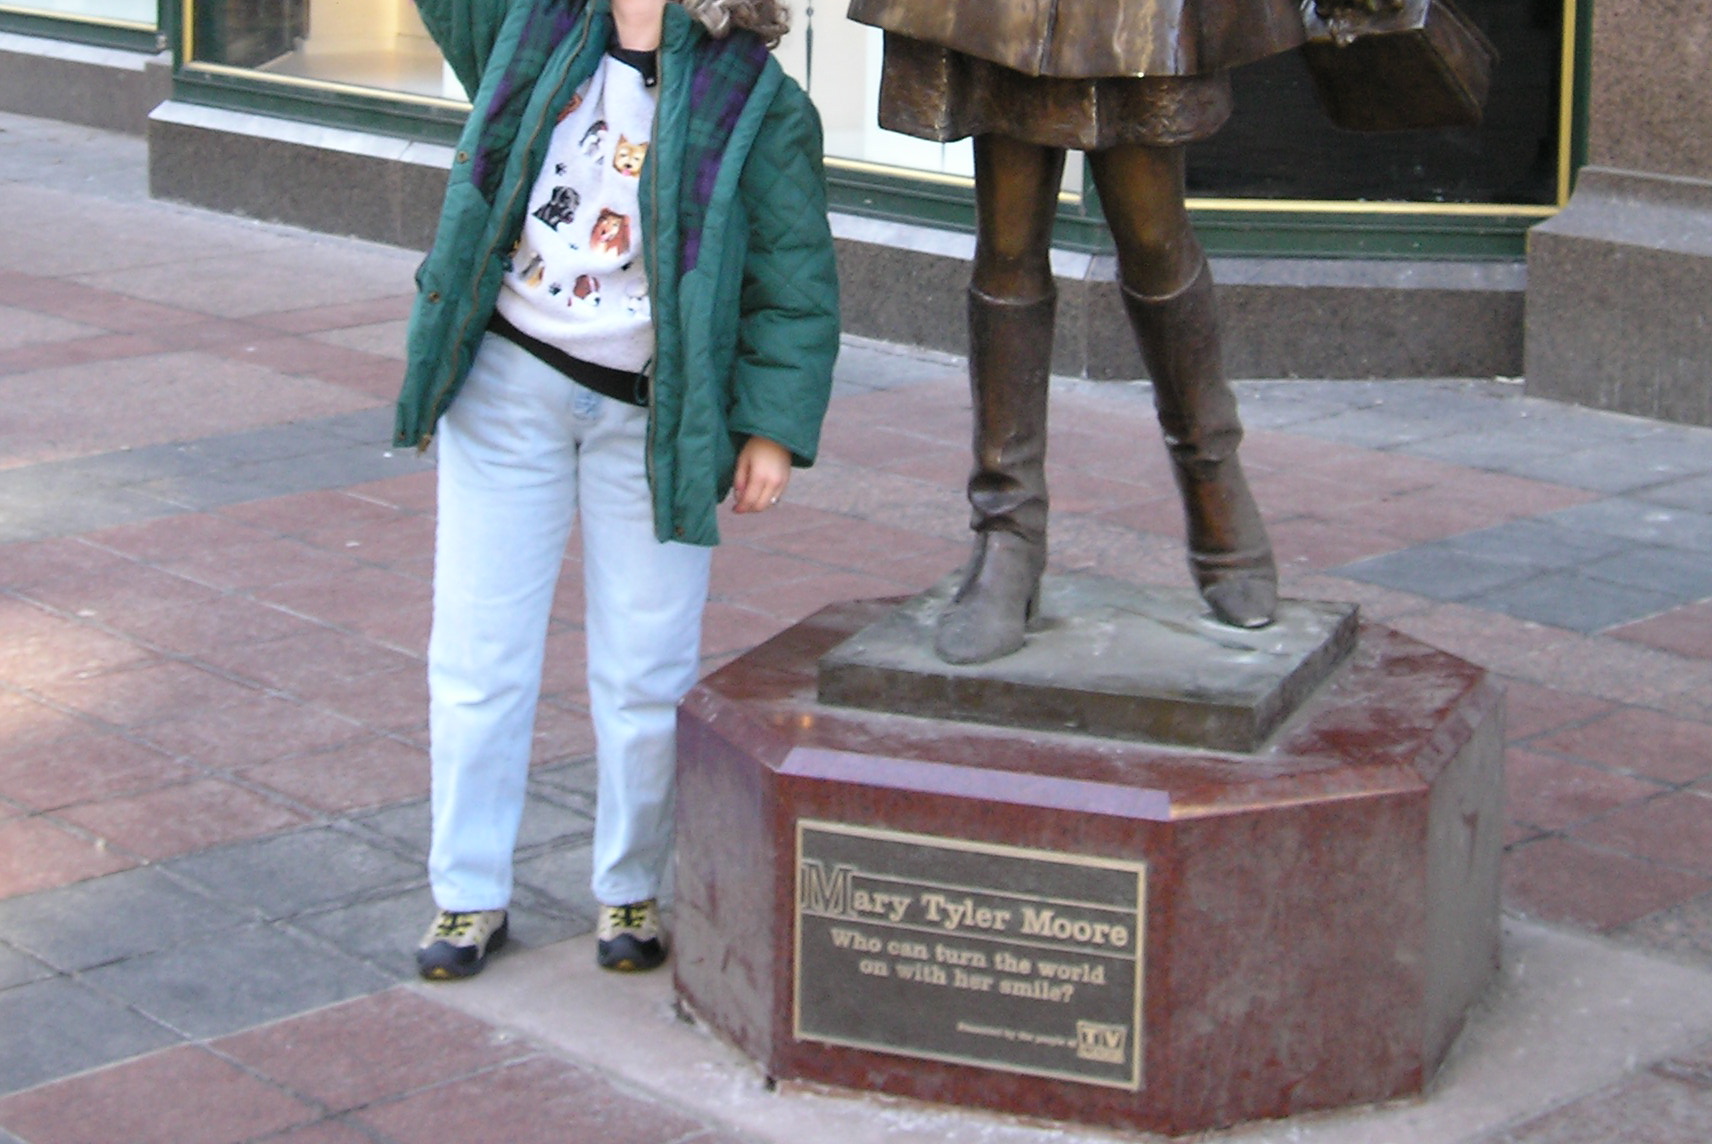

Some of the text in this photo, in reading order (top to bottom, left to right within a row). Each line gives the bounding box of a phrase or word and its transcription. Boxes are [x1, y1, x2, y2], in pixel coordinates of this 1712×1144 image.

[800, 857, 1129, 947] Mary Tyler Moore
[830, 927, 1106, 986] Who can turn the world
[858, 958, 1075, 1004] on with her smile?
[1082, 1027, 1121, 1049] TV
